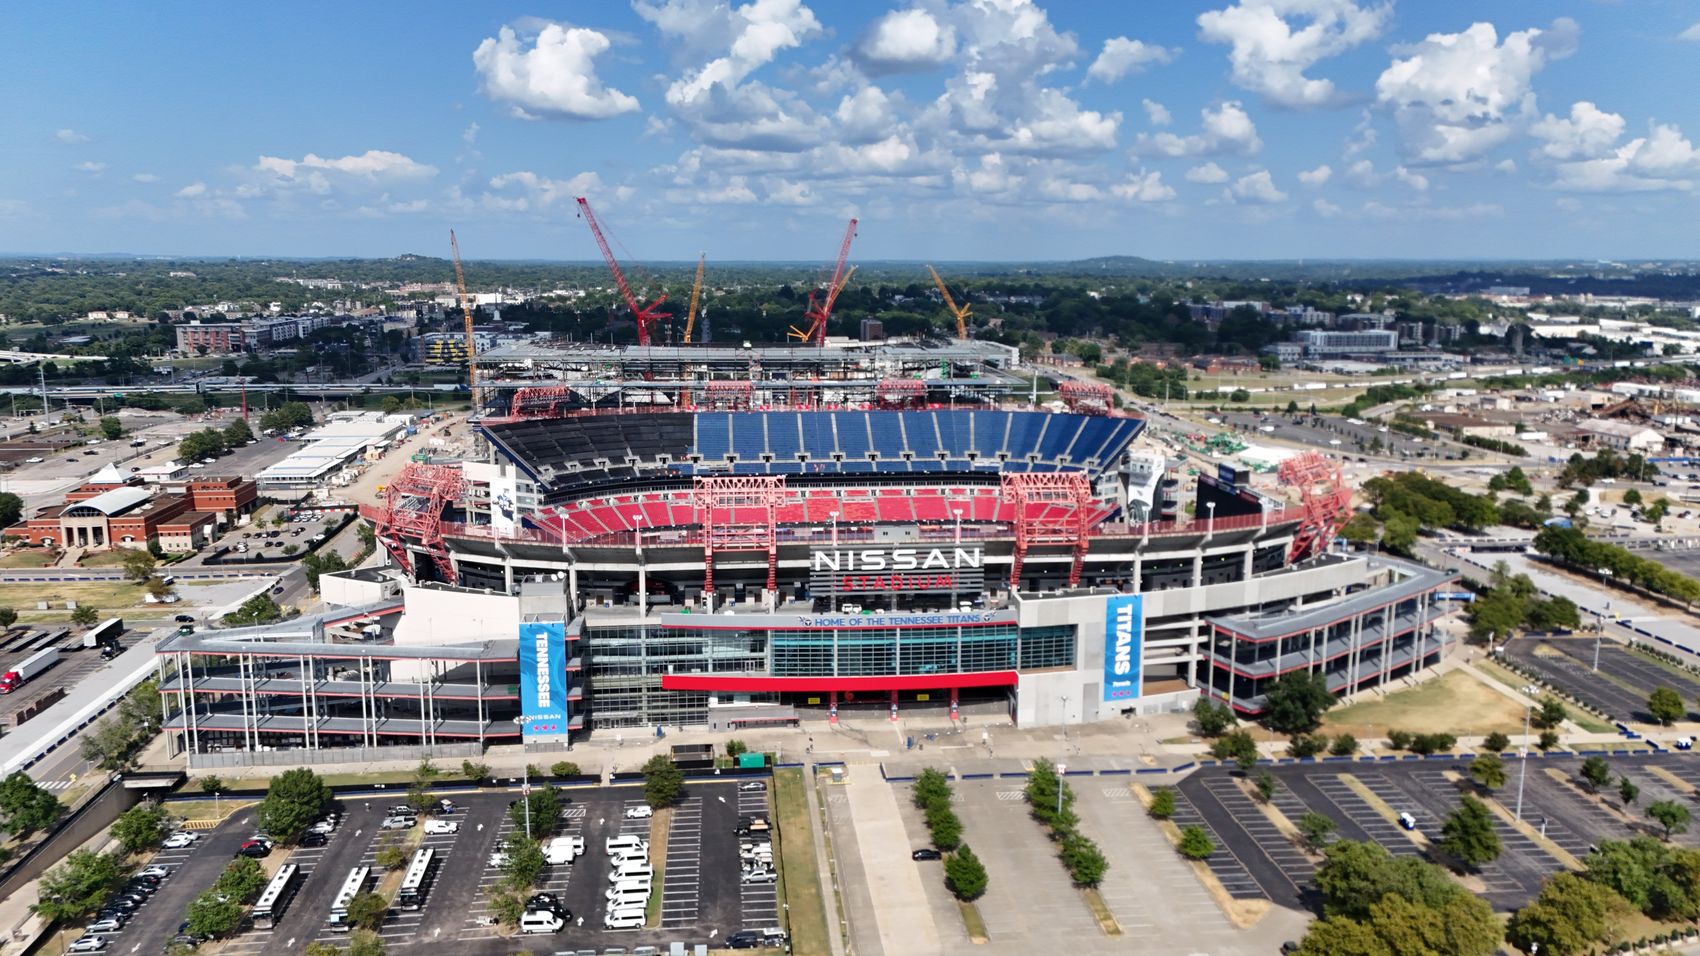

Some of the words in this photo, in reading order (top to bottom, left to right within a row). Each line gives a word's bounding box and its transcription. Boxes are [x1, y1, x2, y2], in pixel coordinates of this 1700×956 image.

[814, 548, 980, 571] NISSAN
[841, 575, 953, 592] STADIUM
[815, 618, 845, 626] HOME
[848, 617, 863, 627] OF
[866, 617, 885, 626] THE
[889, 616, 943, 625] TENNESSEE
[946, 614, 981, 623] TITANS
[1115, 604, 1132, 675] TITANS
[536, 632, 550, 708] TENNESSEE
